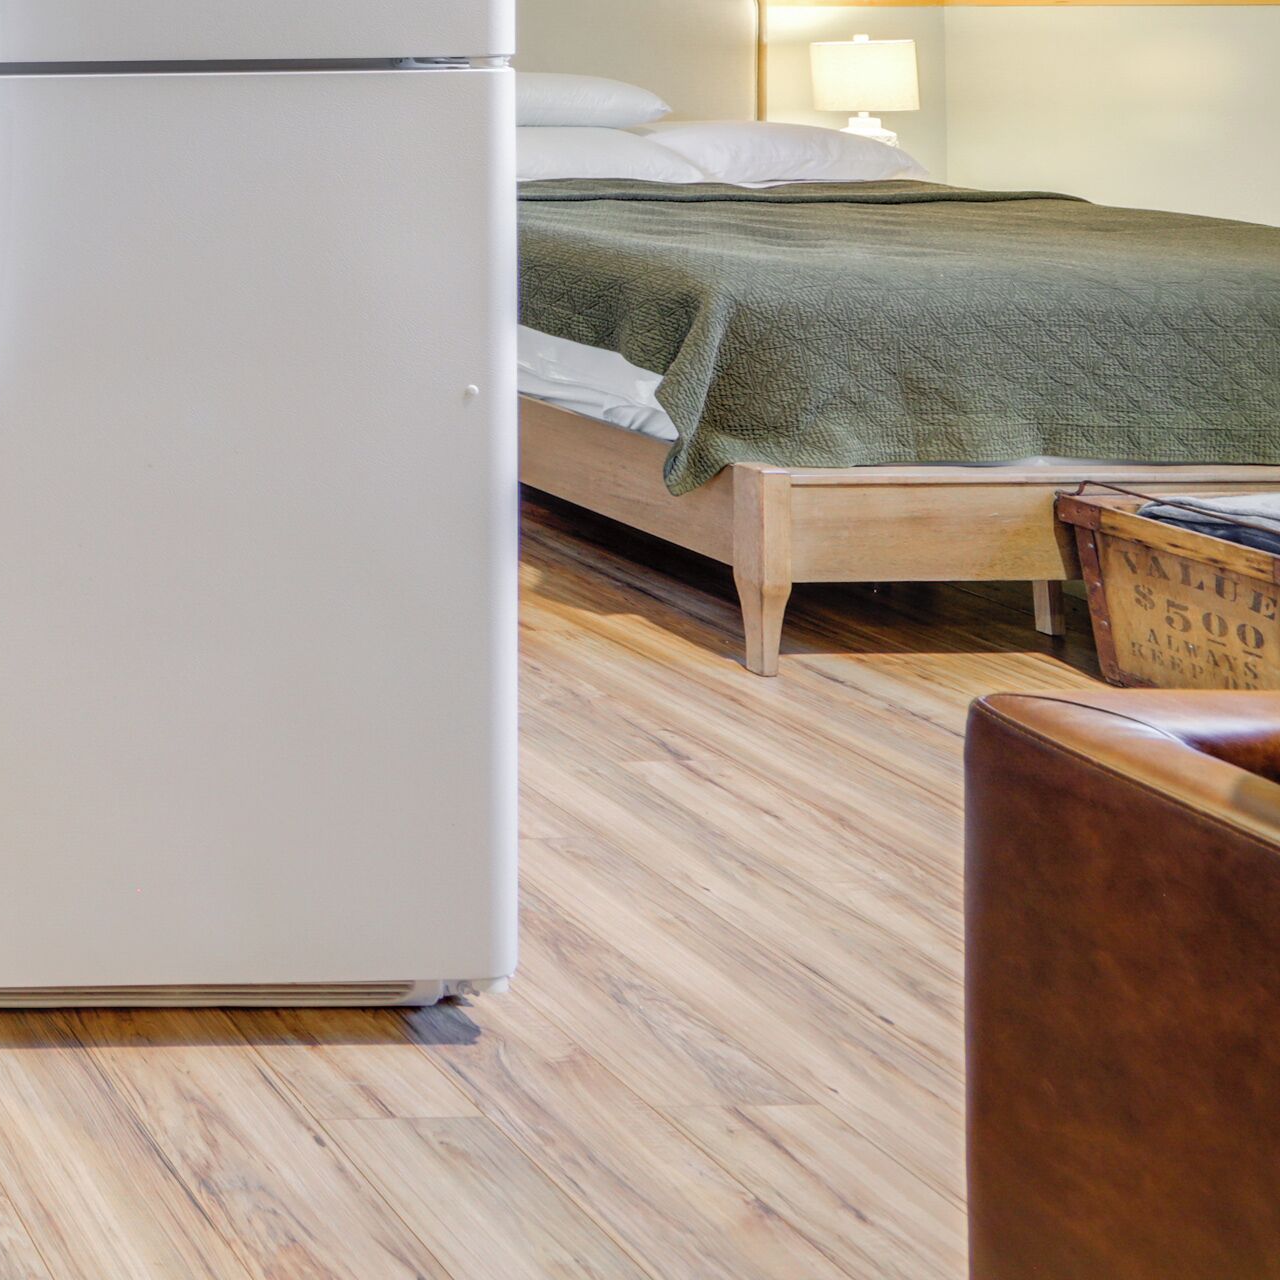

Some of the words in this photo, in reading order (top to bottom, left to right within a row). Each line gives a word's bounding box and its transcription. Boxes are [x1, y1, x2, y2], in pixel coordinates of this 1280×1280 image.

[1122, 550, 1278, 620] VALUE
[1131, 641, 1204, 680] KEEP
[1147, 628, 1259, 680] ALWAYS
